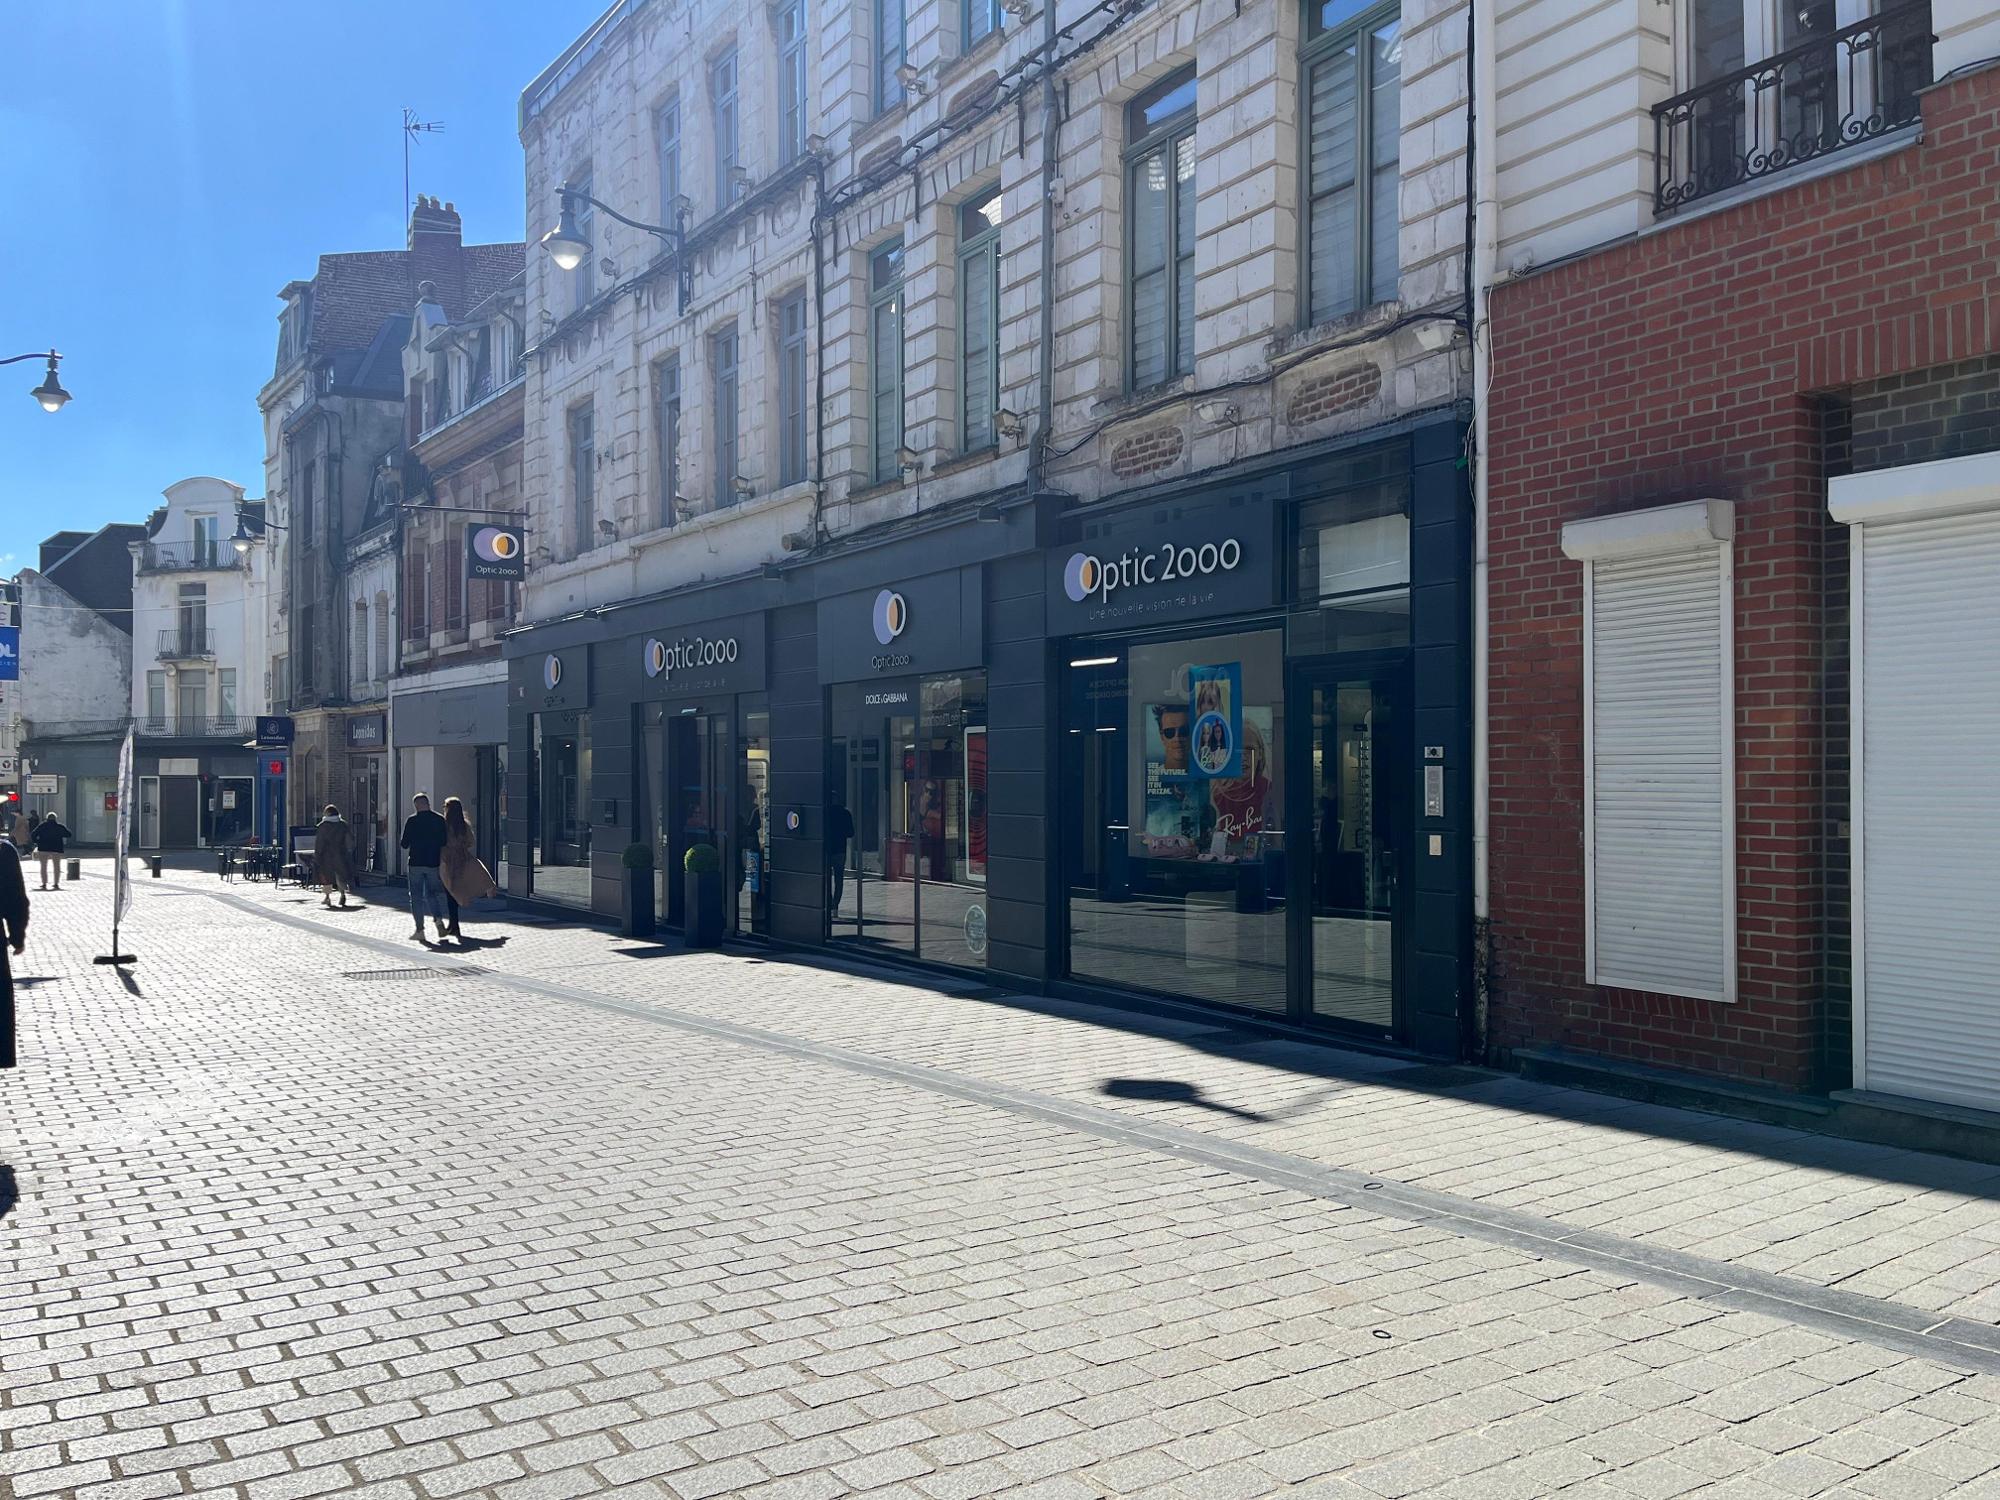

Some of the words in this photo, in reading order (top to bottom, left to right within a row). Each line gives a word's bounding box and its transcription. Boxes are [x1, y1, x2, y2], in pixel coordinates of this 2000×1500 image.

[475, 565, 498, 575] Optic
[498, 568, 518, 576] 2000
[1079, 546, 1156, 603] Optic
[1161, 538, 1241, 581] 2000
[1089, 607, 1105, 620] Une
[1108, 602, 1144, 617] nouvelle
[653, 637, 694, 681] Optic
[696, 637, 738, 667] 2000
[871, 655, 891, 671] Optic
[891, 654, 910, 667] 2000
[352, 722, 377, 740] Leonidas
